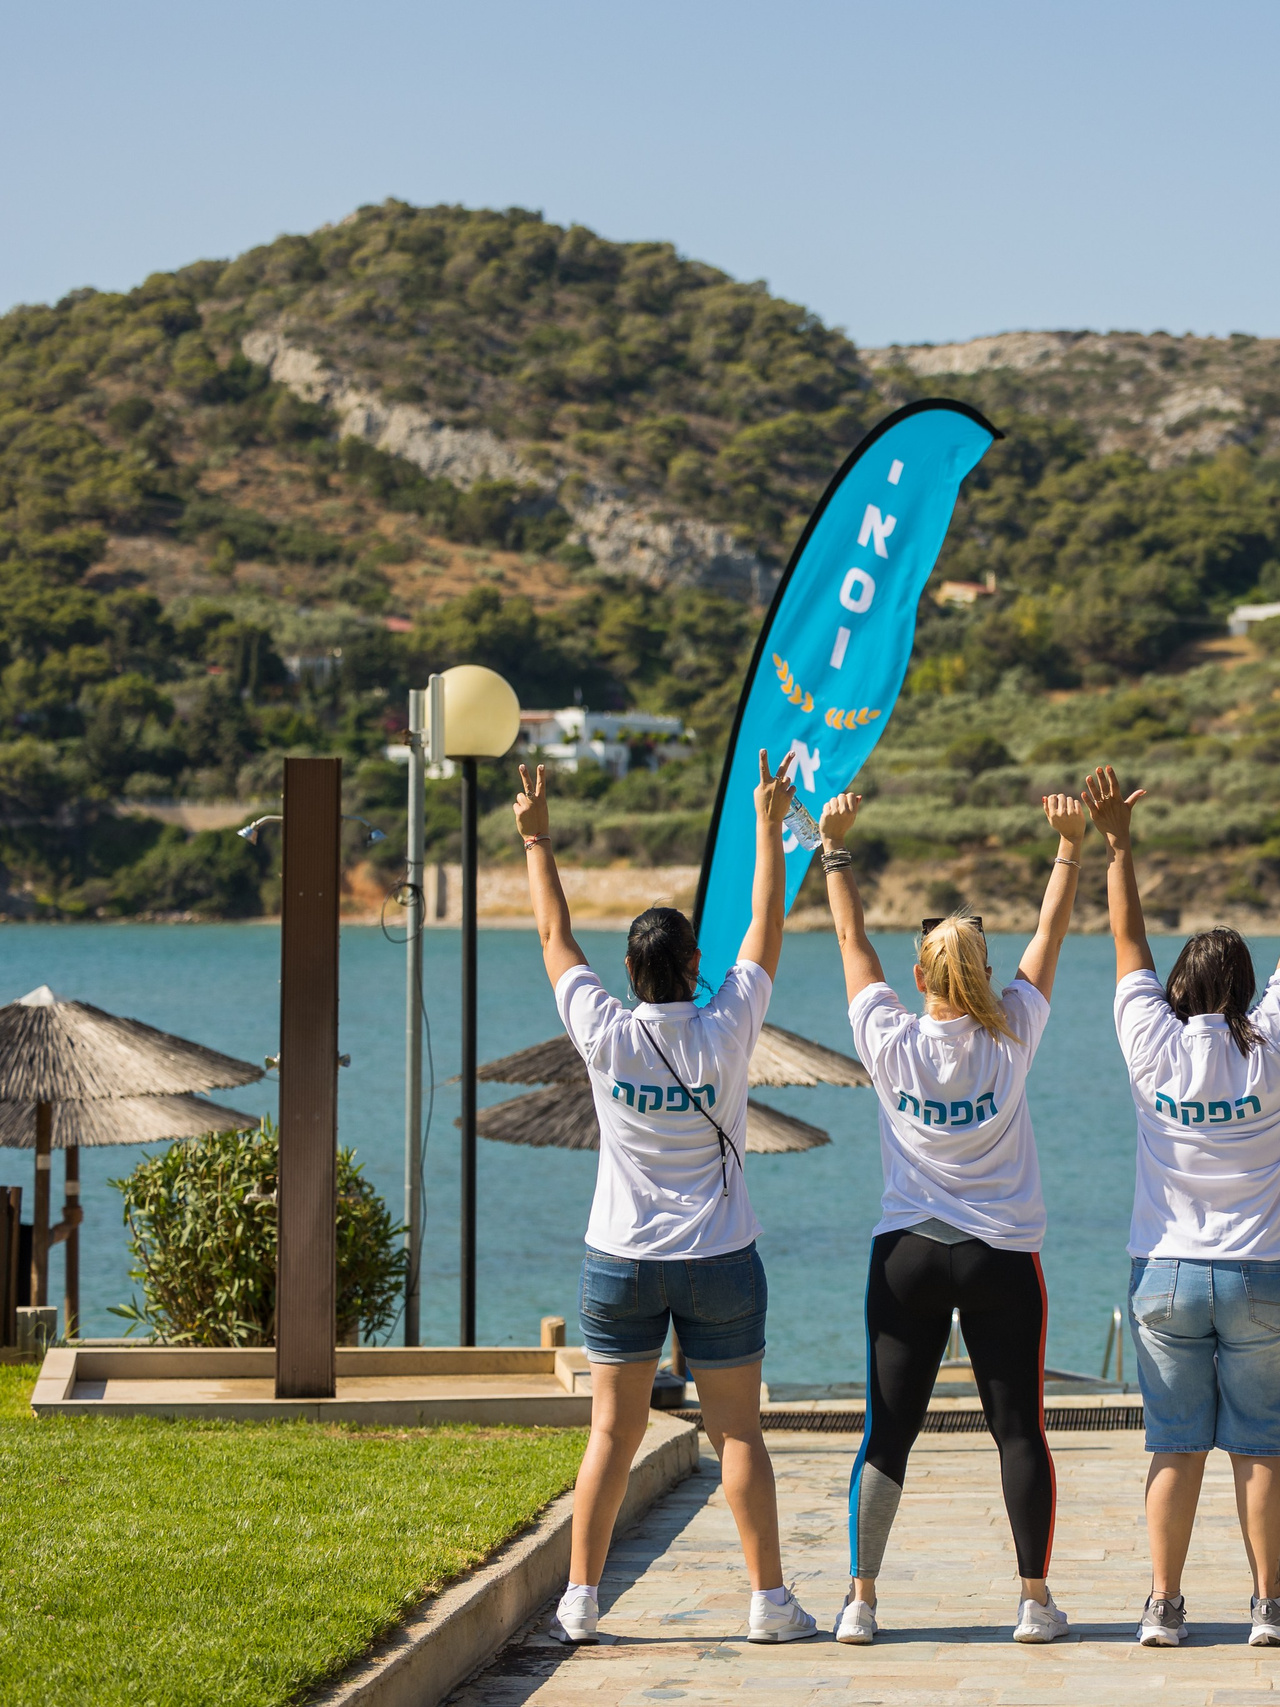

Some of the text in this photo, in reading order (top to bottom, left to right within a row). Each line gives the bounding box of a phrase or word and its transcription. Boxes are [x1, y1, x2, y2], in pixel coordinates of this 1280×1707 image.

[829, 459, 905, 670] יאסו
[612, 1078, 716, 1114] הפקה
[896, 1089, 998, 1127] הפקה
[1155, 1091, 1262, 1126] הפקה
